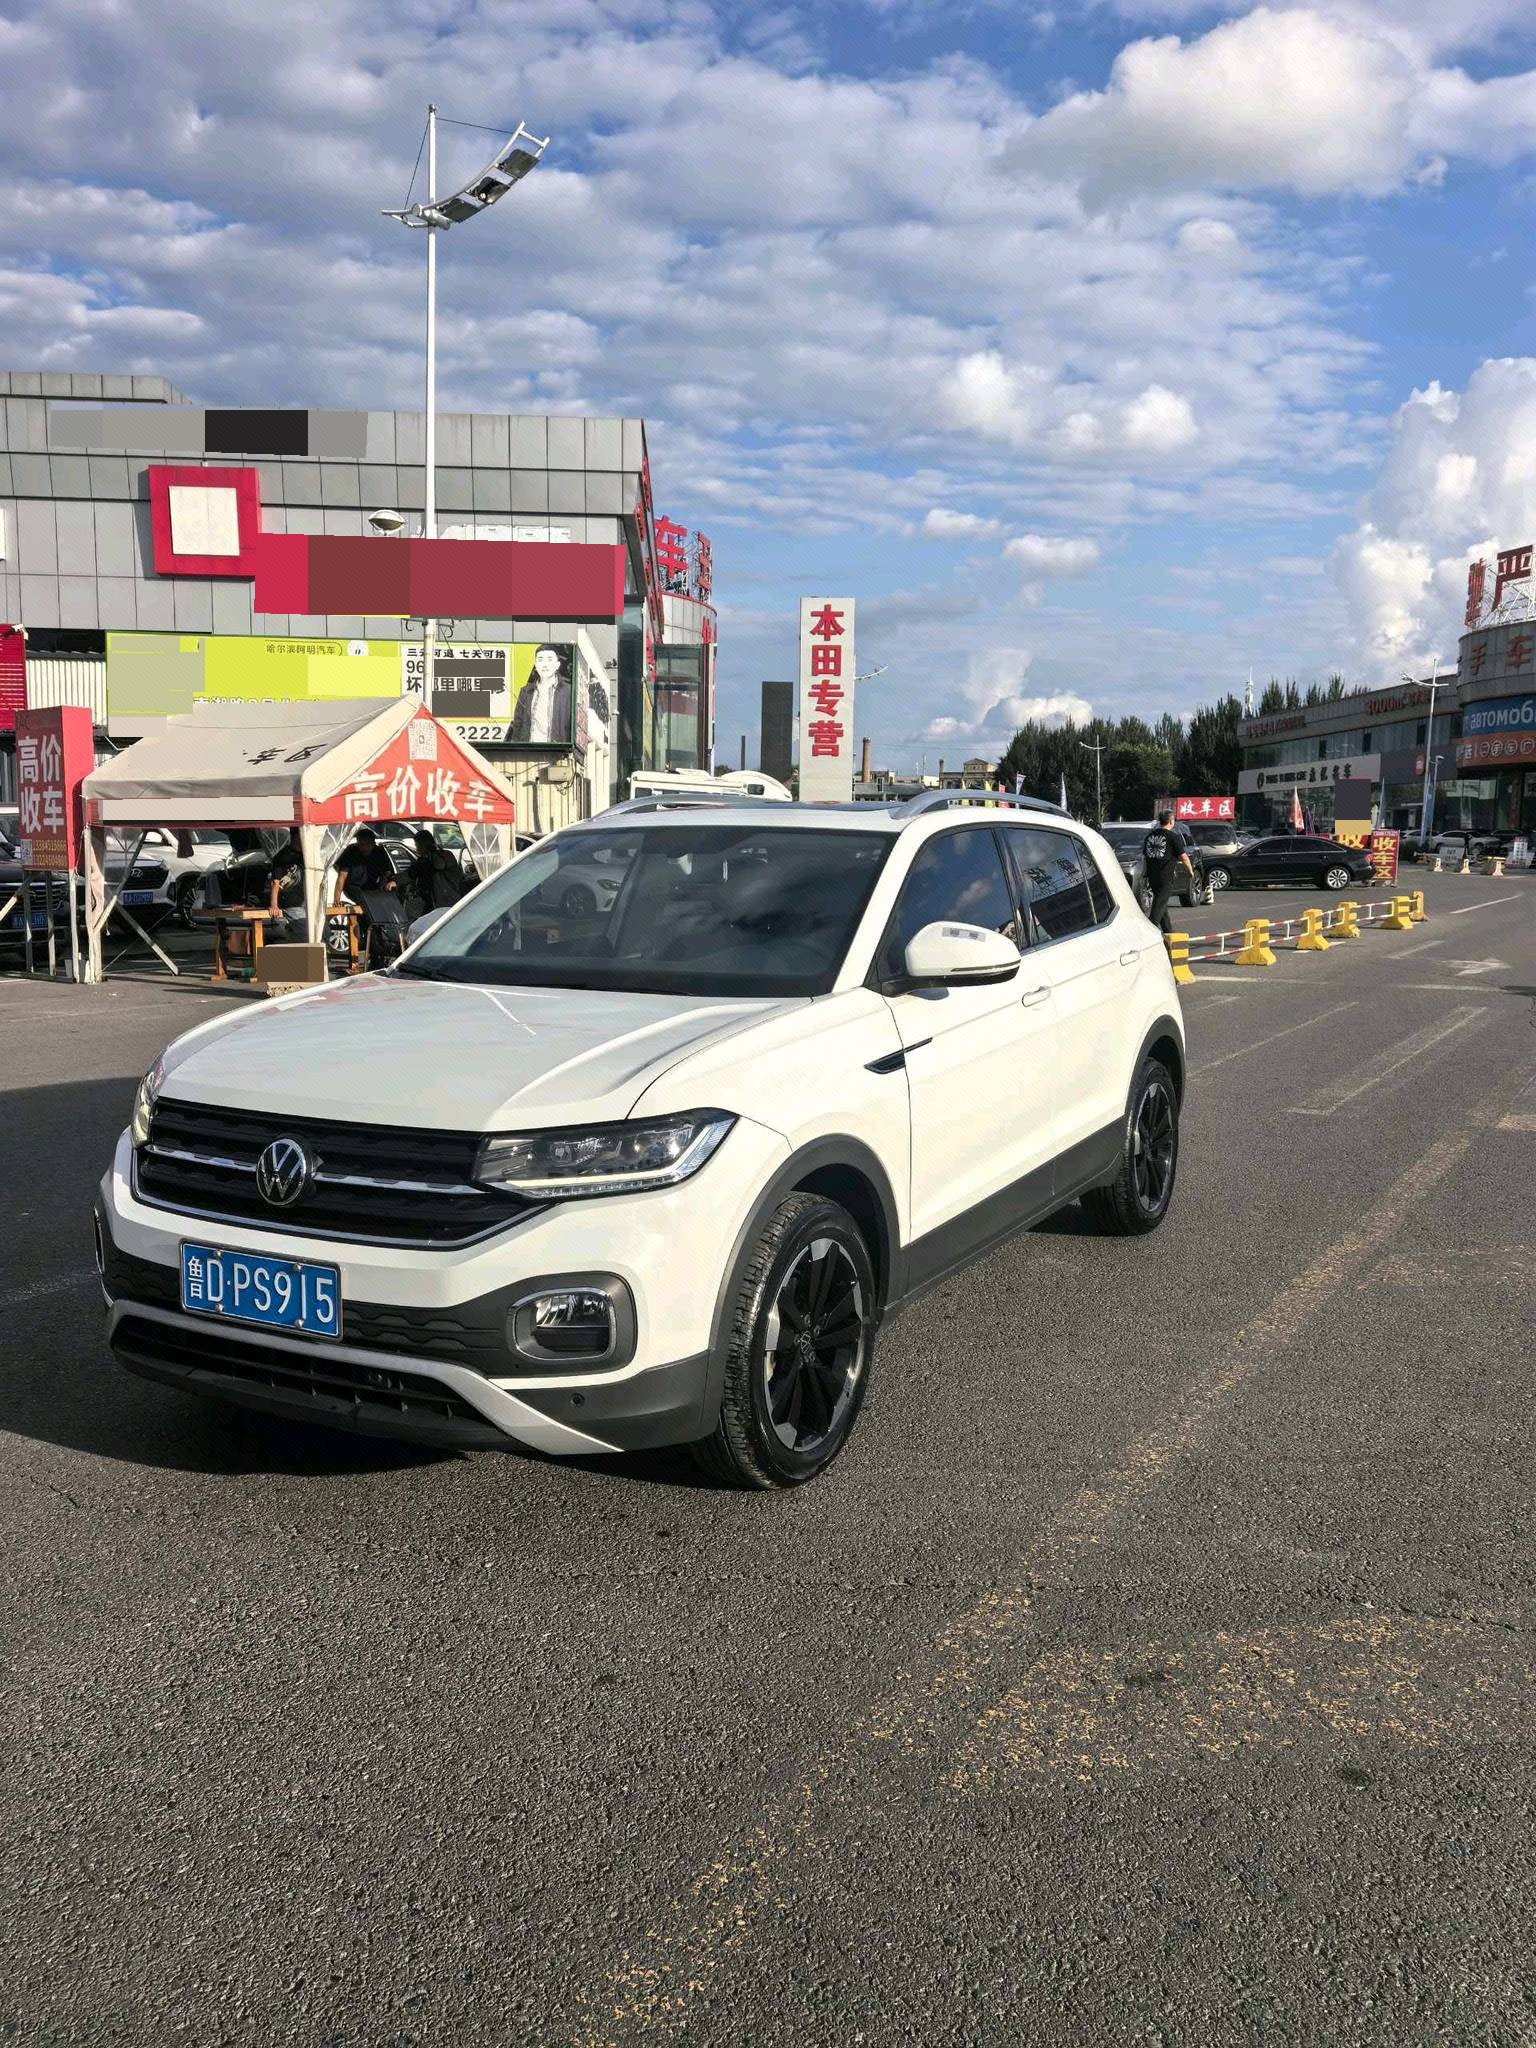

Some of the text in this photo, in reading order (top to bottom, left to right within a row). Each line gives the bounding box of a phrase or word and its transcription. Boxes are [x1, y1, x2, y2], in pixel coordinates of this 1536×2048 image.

[809, 603, 846, 757] 本田专营
[1471, 700, 1536, 729] автомоб
[18, 734, 62, 783] 高价
[20, 785, 65, 835] 收车
[345, 765, 495, 820] 高价收车
[1179, 800, 1234, 818] 收车区
[1373, 836, 1396, 879] 收车区
